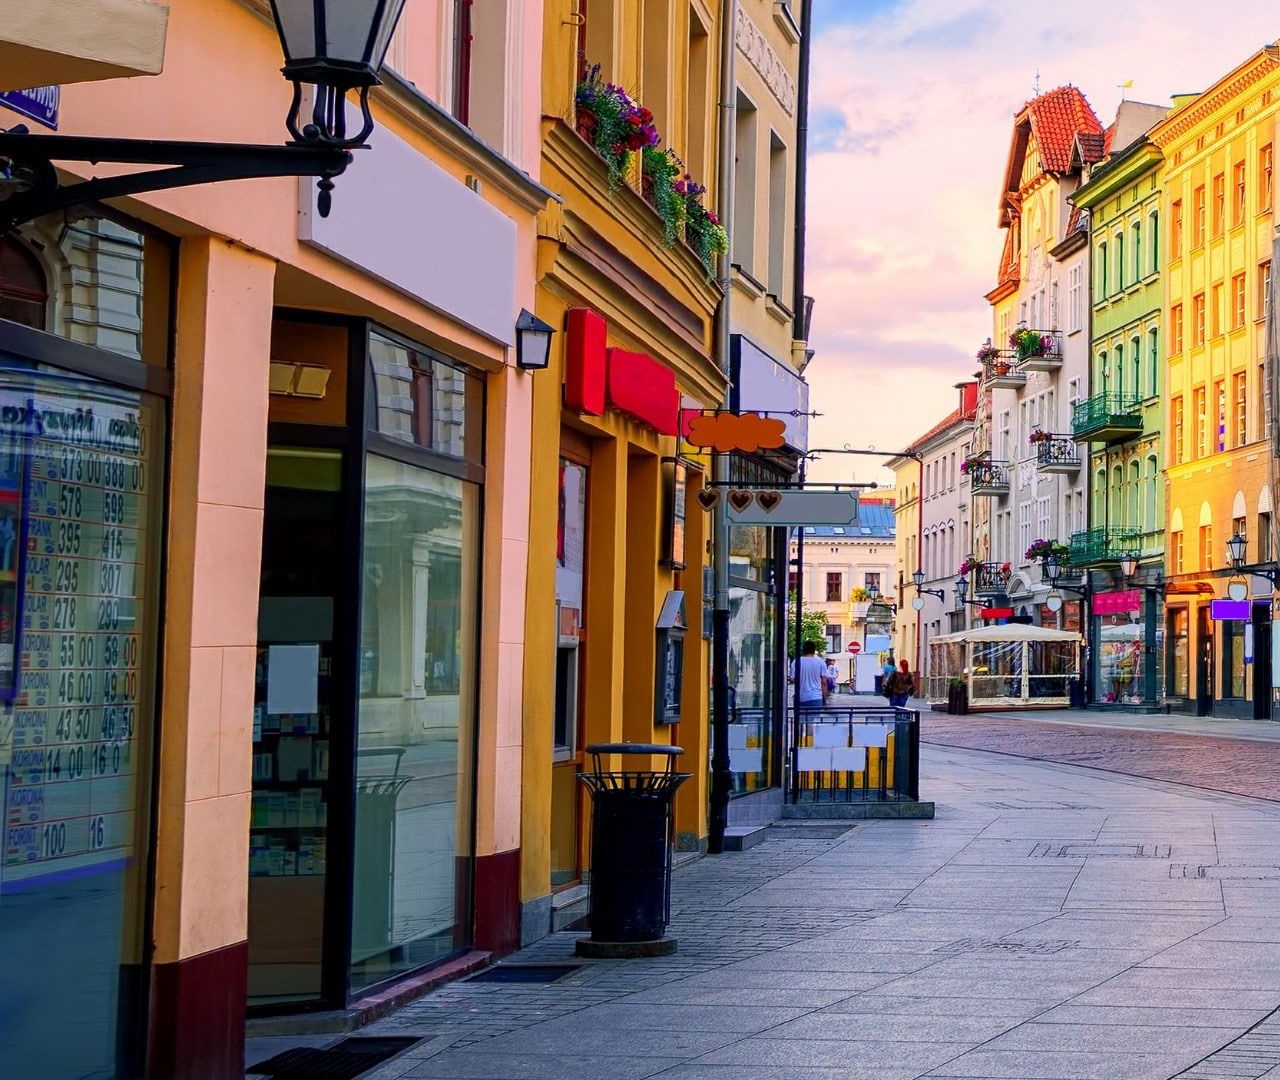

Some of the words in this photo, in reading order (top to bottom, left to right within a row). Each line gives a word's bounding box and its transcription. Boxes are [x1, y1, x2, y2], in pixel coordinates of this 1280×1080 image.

[61, 447, 83, 482] 373
[104, 457, 125, 490] 388
[60, 484, 82, 519] 578
[104, 492, 124, 524] 598
[58, 522, 80, 555] 395
[102, 529, 123, 560] 415
[56, 560, 80, 593] 295
[101, 564, 121, 595] 307
[53, 597, 77, 630] 278
[98, 600, 119, 630] 290
[60, 635, 75, 667] 55
[79, 636, 94, 668] 00
[104, 635, 119, 666] 58
[58, 671, 75, 703] 46
[79, 672, 93, 704] 00
[104, 671, 118, 703] 49
[56, 708, 73, 742] 43
[75, 708, 90, 740] 50
[46, 747, 61, 781] 14
[68, 745, 84, 780] 00
[92, 744, 107, 775] 16
[43, 822, 66, 858] 100
[90, 815, 104, 849] 16
